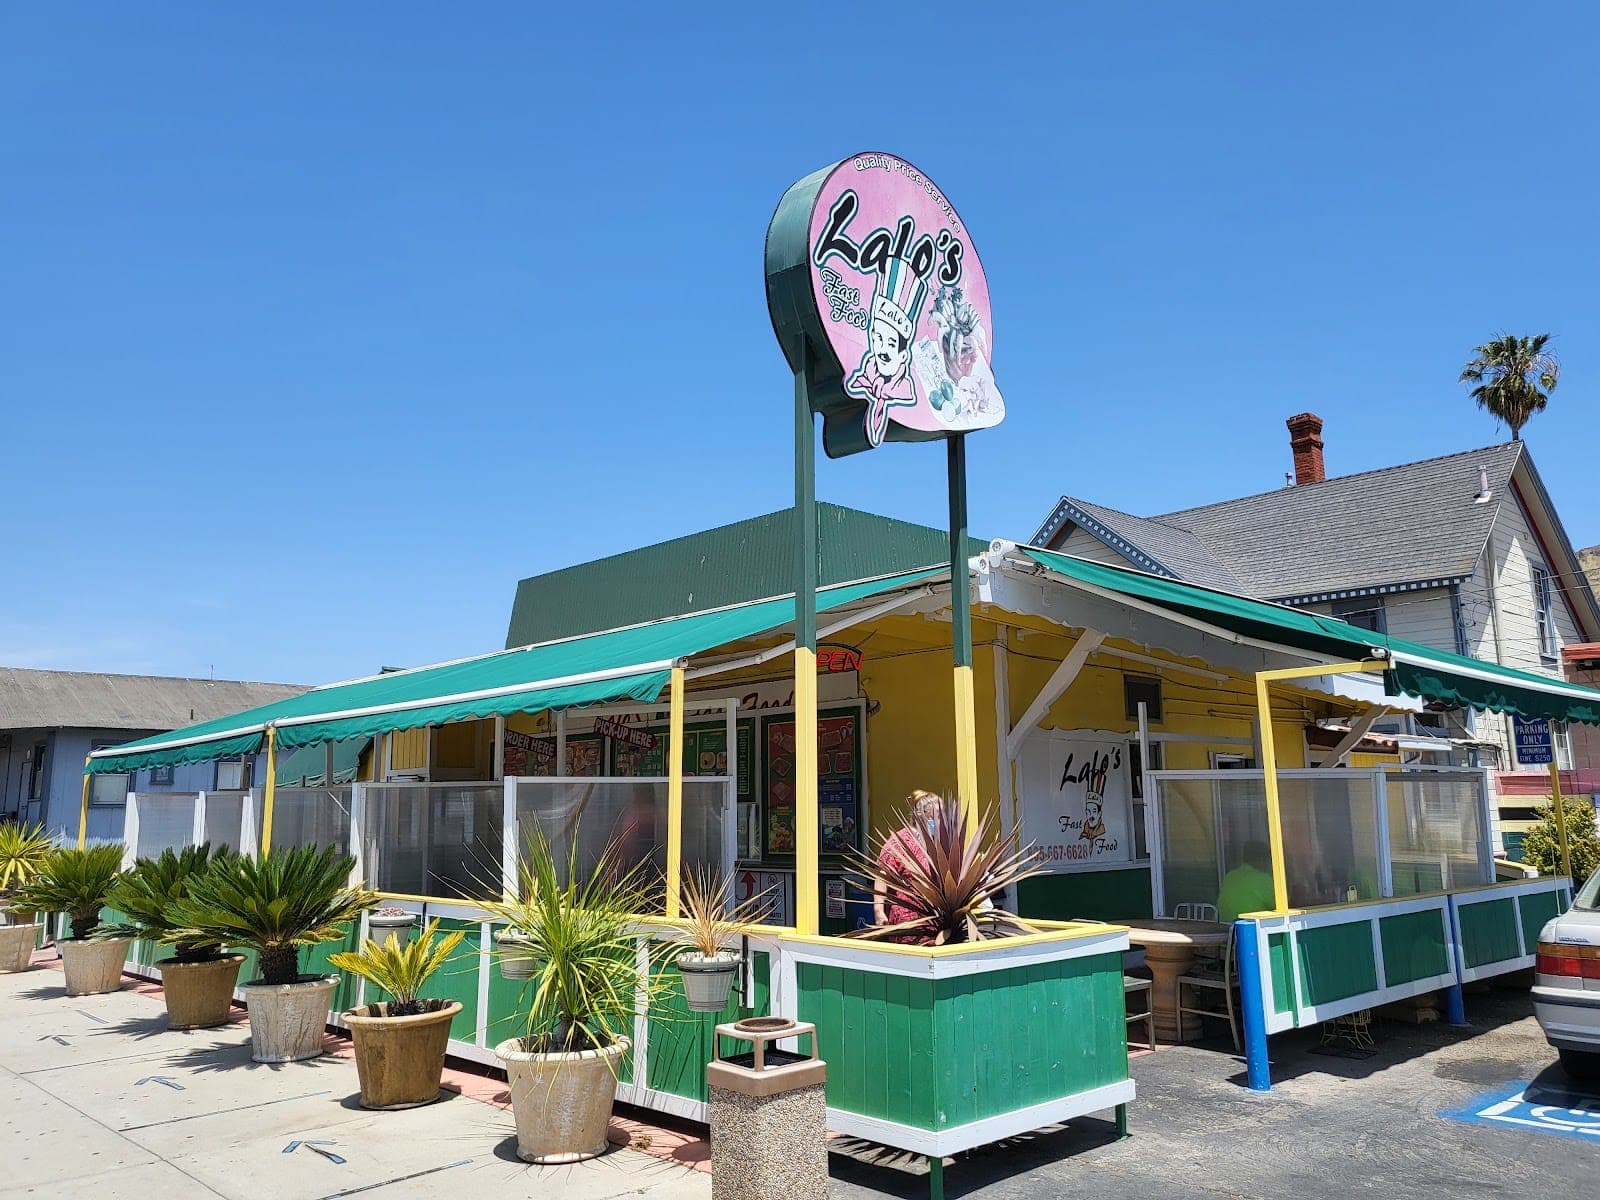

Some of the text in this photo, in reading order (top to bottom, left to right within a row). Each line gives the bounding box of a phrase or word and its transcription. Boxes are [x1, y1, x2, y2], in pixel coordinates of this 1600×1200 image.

[854, 155, 960, 233] Quality Price Service
[815, 190, 963, 287] Lalo's
[821, 267, 859, 305] Fast
[829, 295, 868, 330] Food
[879, 301, 909, 333] Lalo's
[816, 649, 864, 672] PEN
[594, 718, 629, 741] PICK-UP
[630, 729, 654, 748] HERE
[1515, 723, 1549, 734] PARKING
[1523, 735, 1543, 745] ONLY
[531, 738, 556, 757] HERE
[1060, 746, 1121, 792] Lalo's
[1058, 815, 1083, 833] Fast
[1094, 838, 1118, 855] Food
